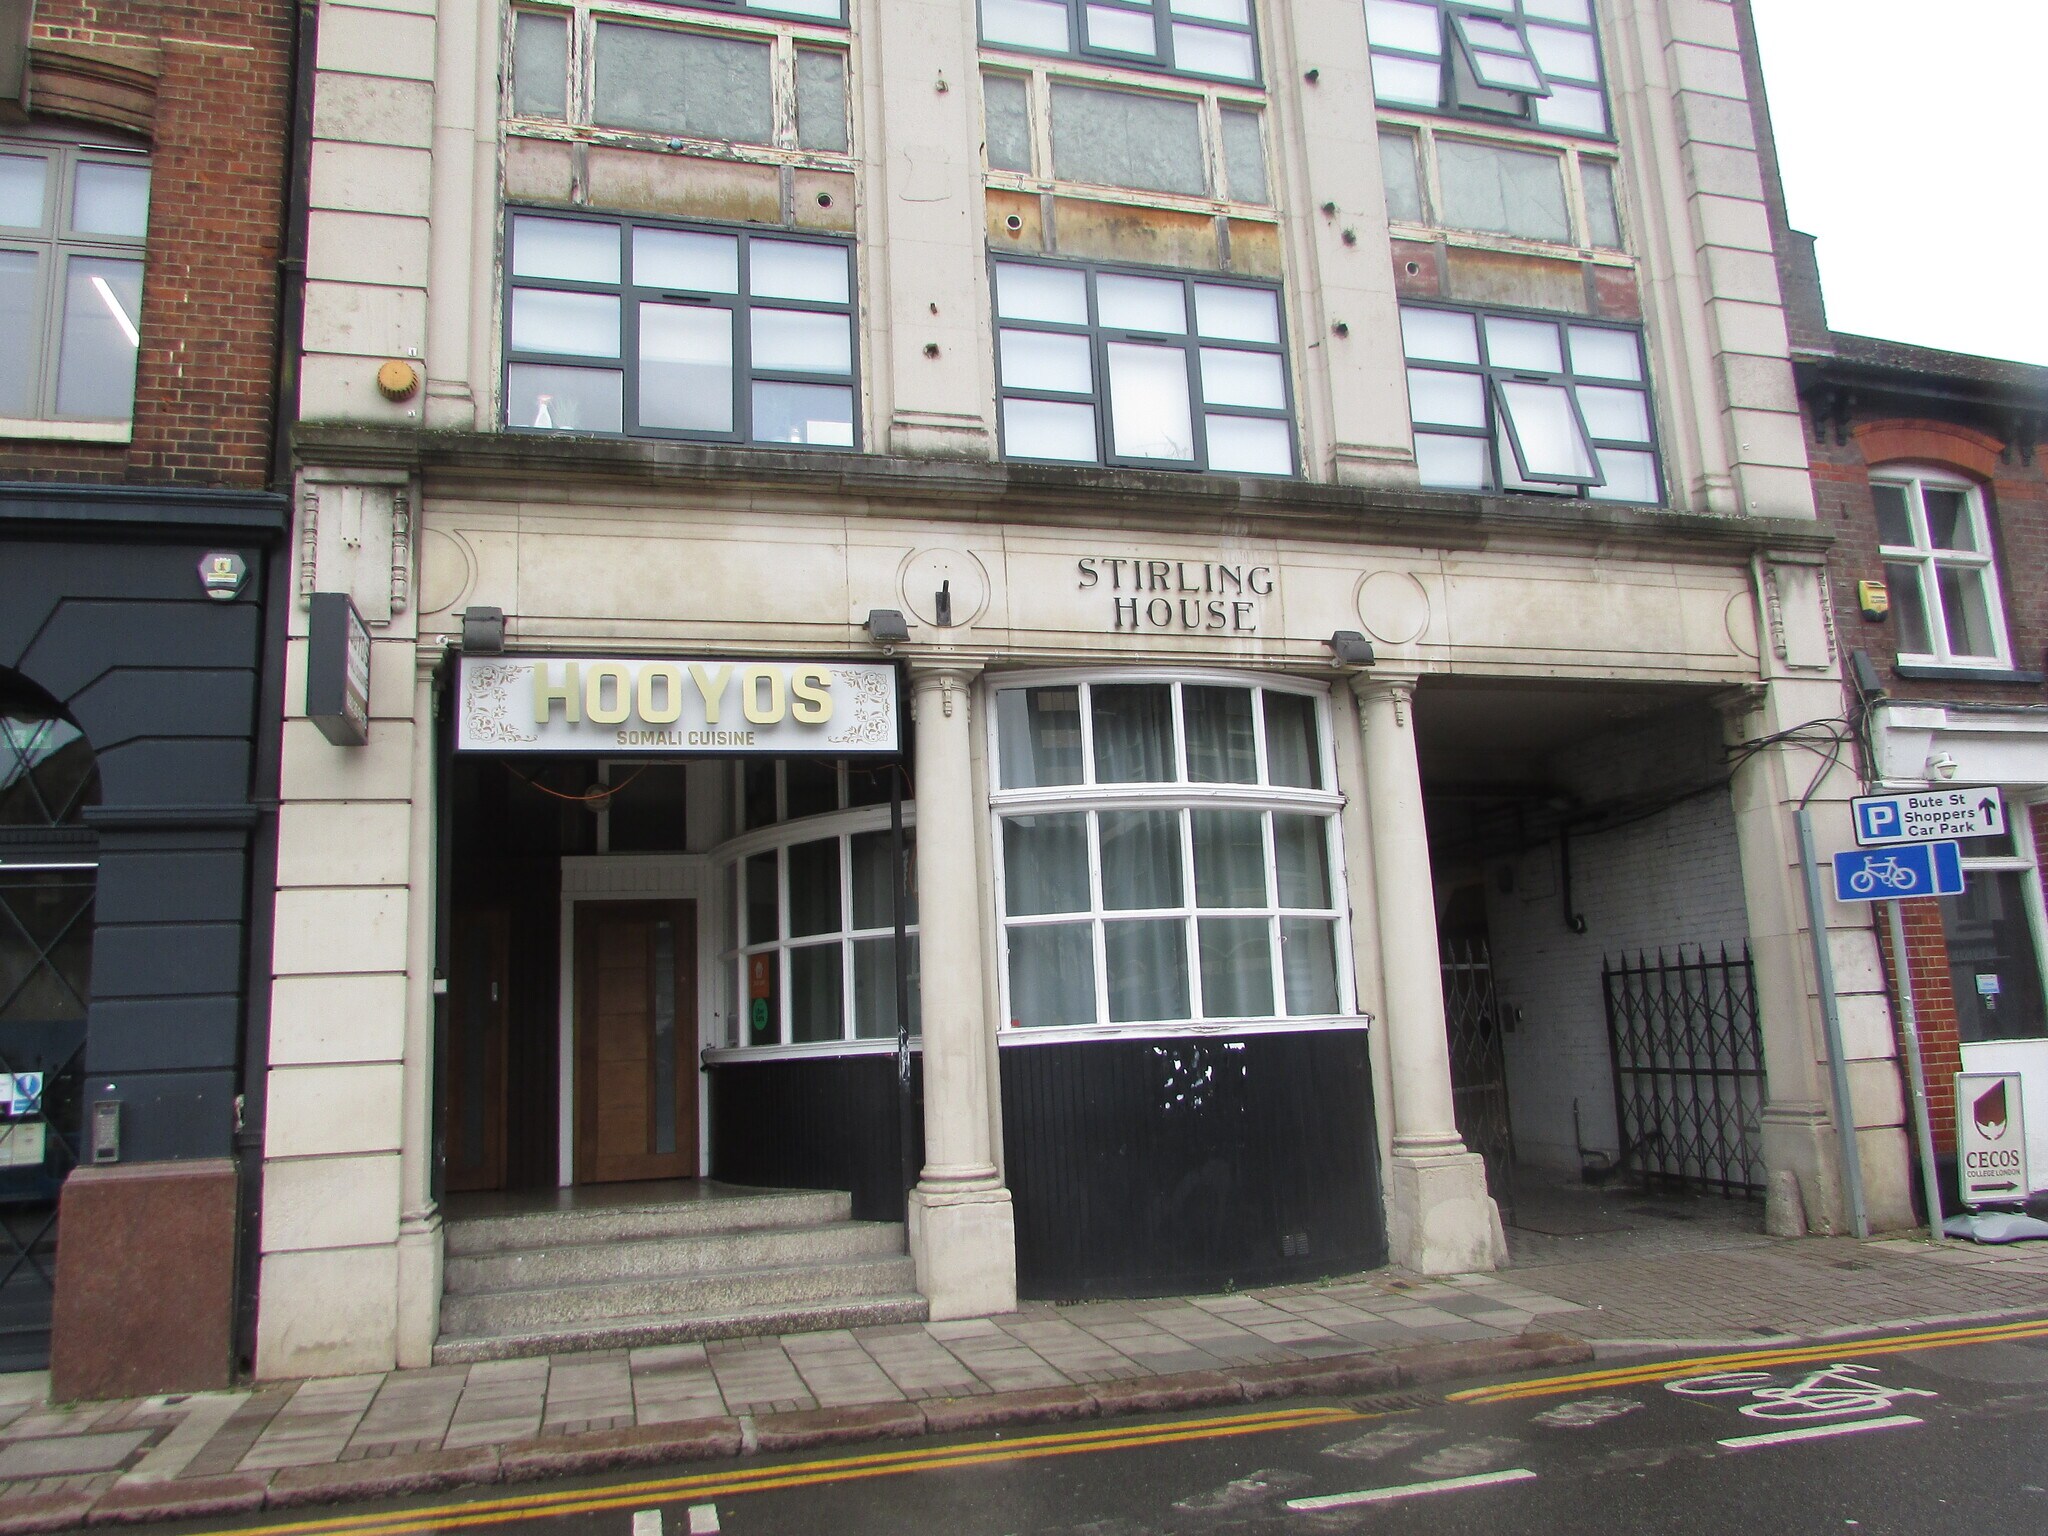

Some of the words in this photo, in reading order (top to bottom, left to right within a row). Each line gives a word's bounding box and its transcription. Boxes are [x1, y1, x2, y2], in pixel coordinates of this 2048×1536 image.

[1077, 557, 1273, 595] STIRLING
[1113, 597, 1257, 631] HOUSE
[533, 661, 834, 725] HOOYOS
[616, 730, 682, 746] SOMALI
[688, 731, 755, 746] CUISINE
[1908, 797, 1943, 809] Bute
[1949, 794, 1966, 806] St
[1868, 806, 1892, 835] P
[1904, 808, 1975, 824] Shoppers
[1908, 825, 1934, 837] Car
[1939, 821, 1975, 835] Park
[1966, 1149, 2020, 1169] CECOS
[1967, 1169, 1995, 1177] COLLEGE
[1996, 1168, 2021, 1177] LONDON
